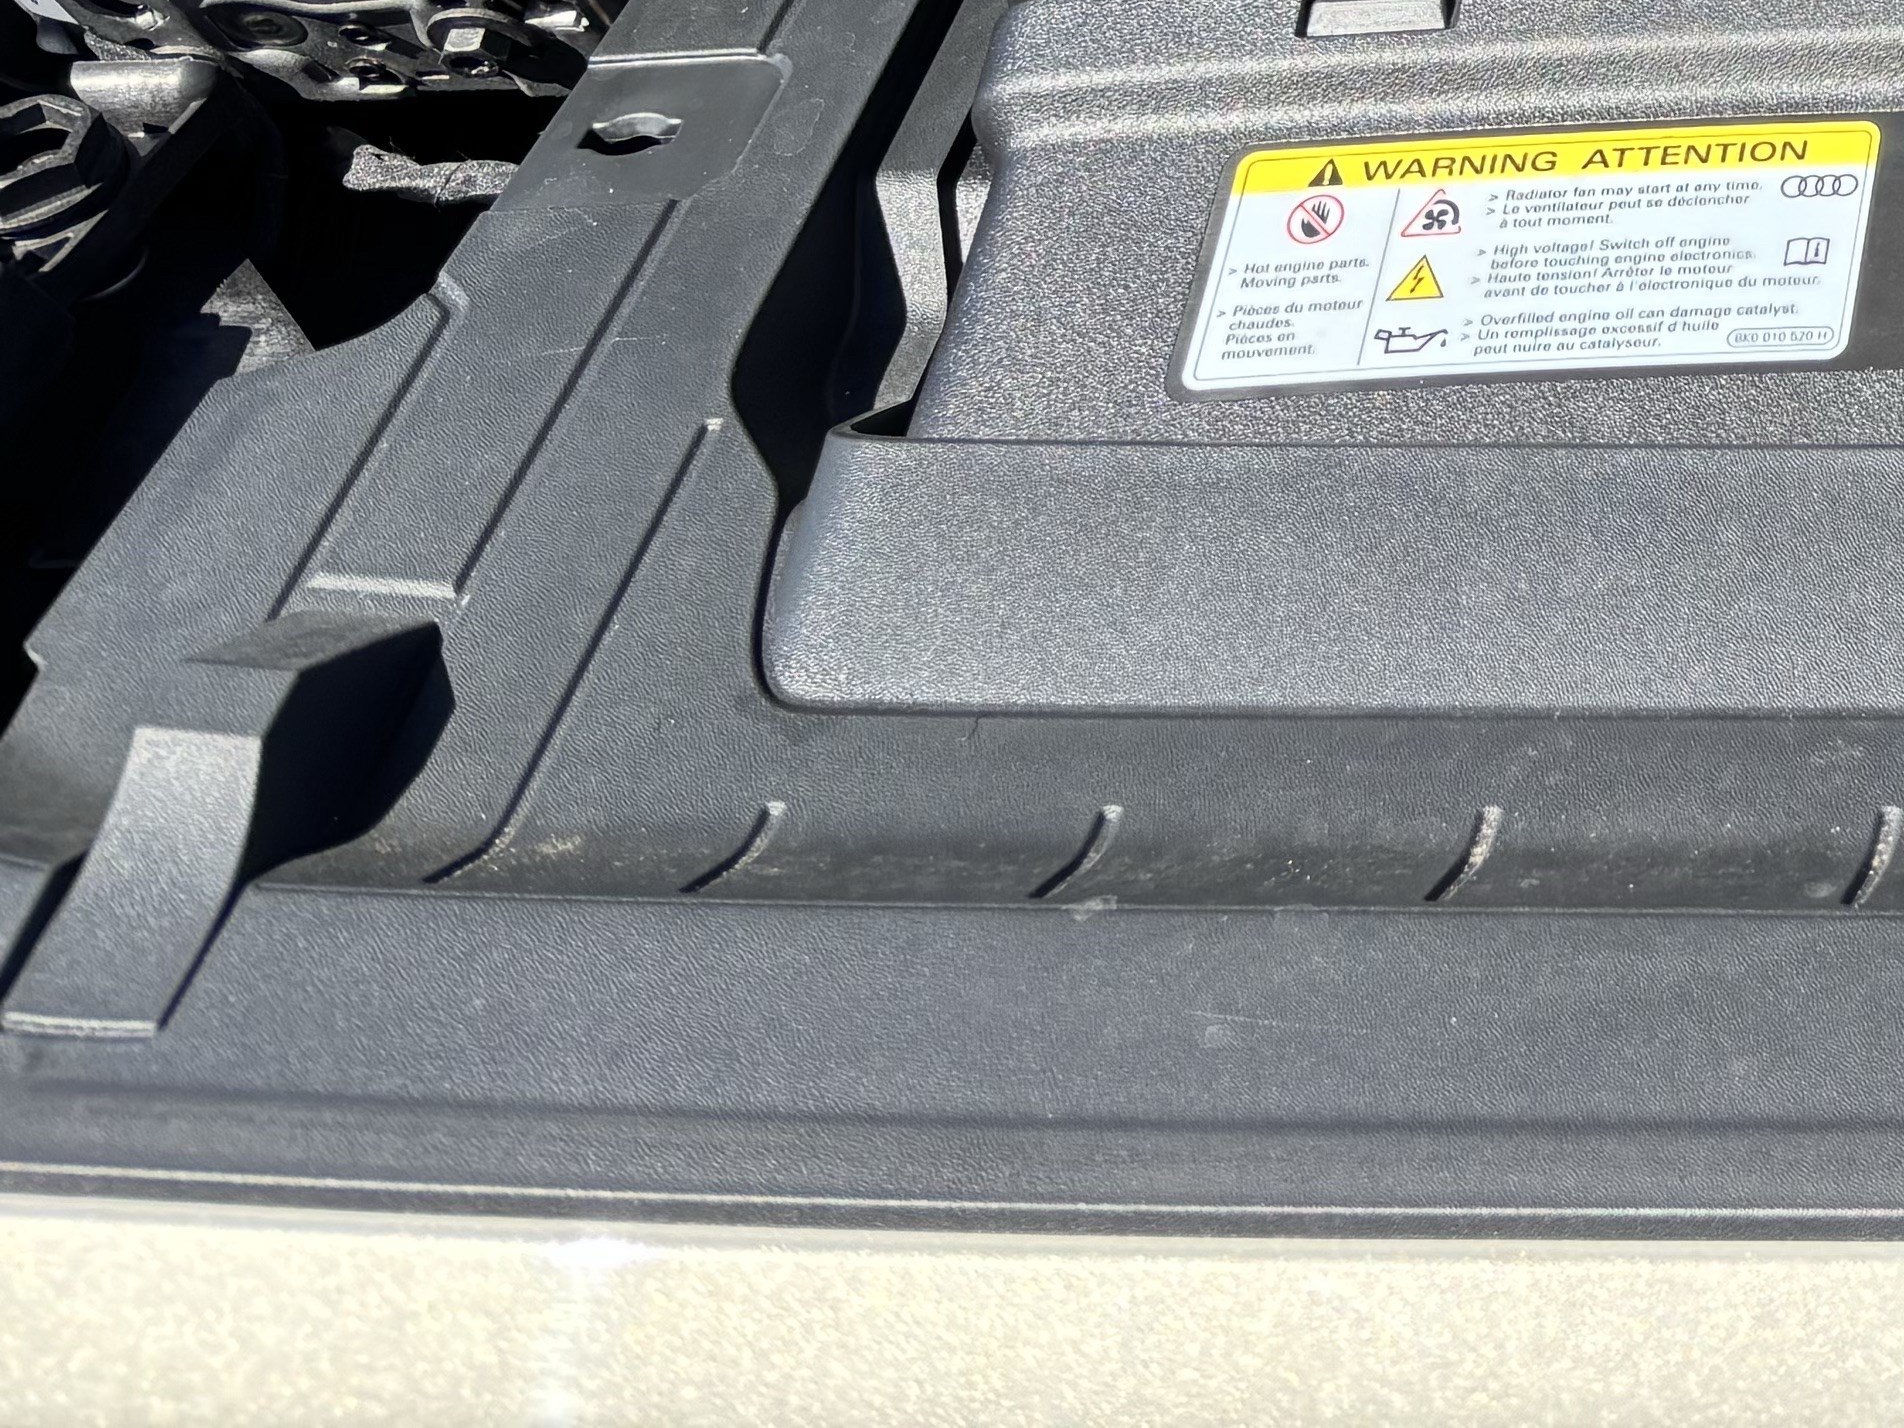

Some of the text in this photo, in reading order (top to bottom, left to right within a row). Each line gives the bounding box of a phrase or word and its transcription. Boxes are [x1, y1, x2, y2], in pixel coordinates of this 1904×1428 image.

[1365, 141, 1808, 181] WARNING ATTENTION
[1505, 181, 1764, 201] Radiator fan may start at any time.
[1502, 204, 1520, 215] Le
[1525, 201, 1604, 214] ventilateur
[1608, 198, 1642, 212] peut
[1646, 198, 1663, 208] se
[1513, 217, 1543, 228] tout
[1493, 244, 1528, 259] High
[1599, 238, 1650, 251] Switch
[1654, 236, 1676, 249] off
[1679, 237, 1730, 250] engine
[1244, 263, 1270, 274] Hot
[1274, 261, 1325, 274] engine
[1490, 257, 1539, 270] before
[1544, 255, 1610, 268] touching
[1614, 254, 1666, 266] engine
[1240, 277, 1297, 289] Moving
[1487, 272, 1531, 284] Haute
[1601, 266, 1655, 278] Arrêter
[1659, 265, 1673, 276] le
[1677, 264, 1732, 275] moteur
[1483, 286, 1526, 298] avant
[1530, 285, 1549, 297] de
[1553, 281, 1612, 295] toucher
[1737, 276, 1757, 288] du
[1284, 301, 1304, 314] du
[1307, 300, 1363, 312] moteur
[1480, 311, 1555, 327] Overfilled
[1558, 310, 1611, 324] engine
[1615, 308, 1634, 320] oil
[1638, 309, 1665, 319] can
[1669, 306, 1732, 319] damage
[1277, 332, 1295, 342] en
[1477, 329, 1499, 341] Un
[1504, 326, 1597, 342] remplissage
[1601, 321, 1664, 335] excessif
[1762, 331, 1787, 343] 010
[1473, 337, 1661, 357] peut nuire au catalyseur.
